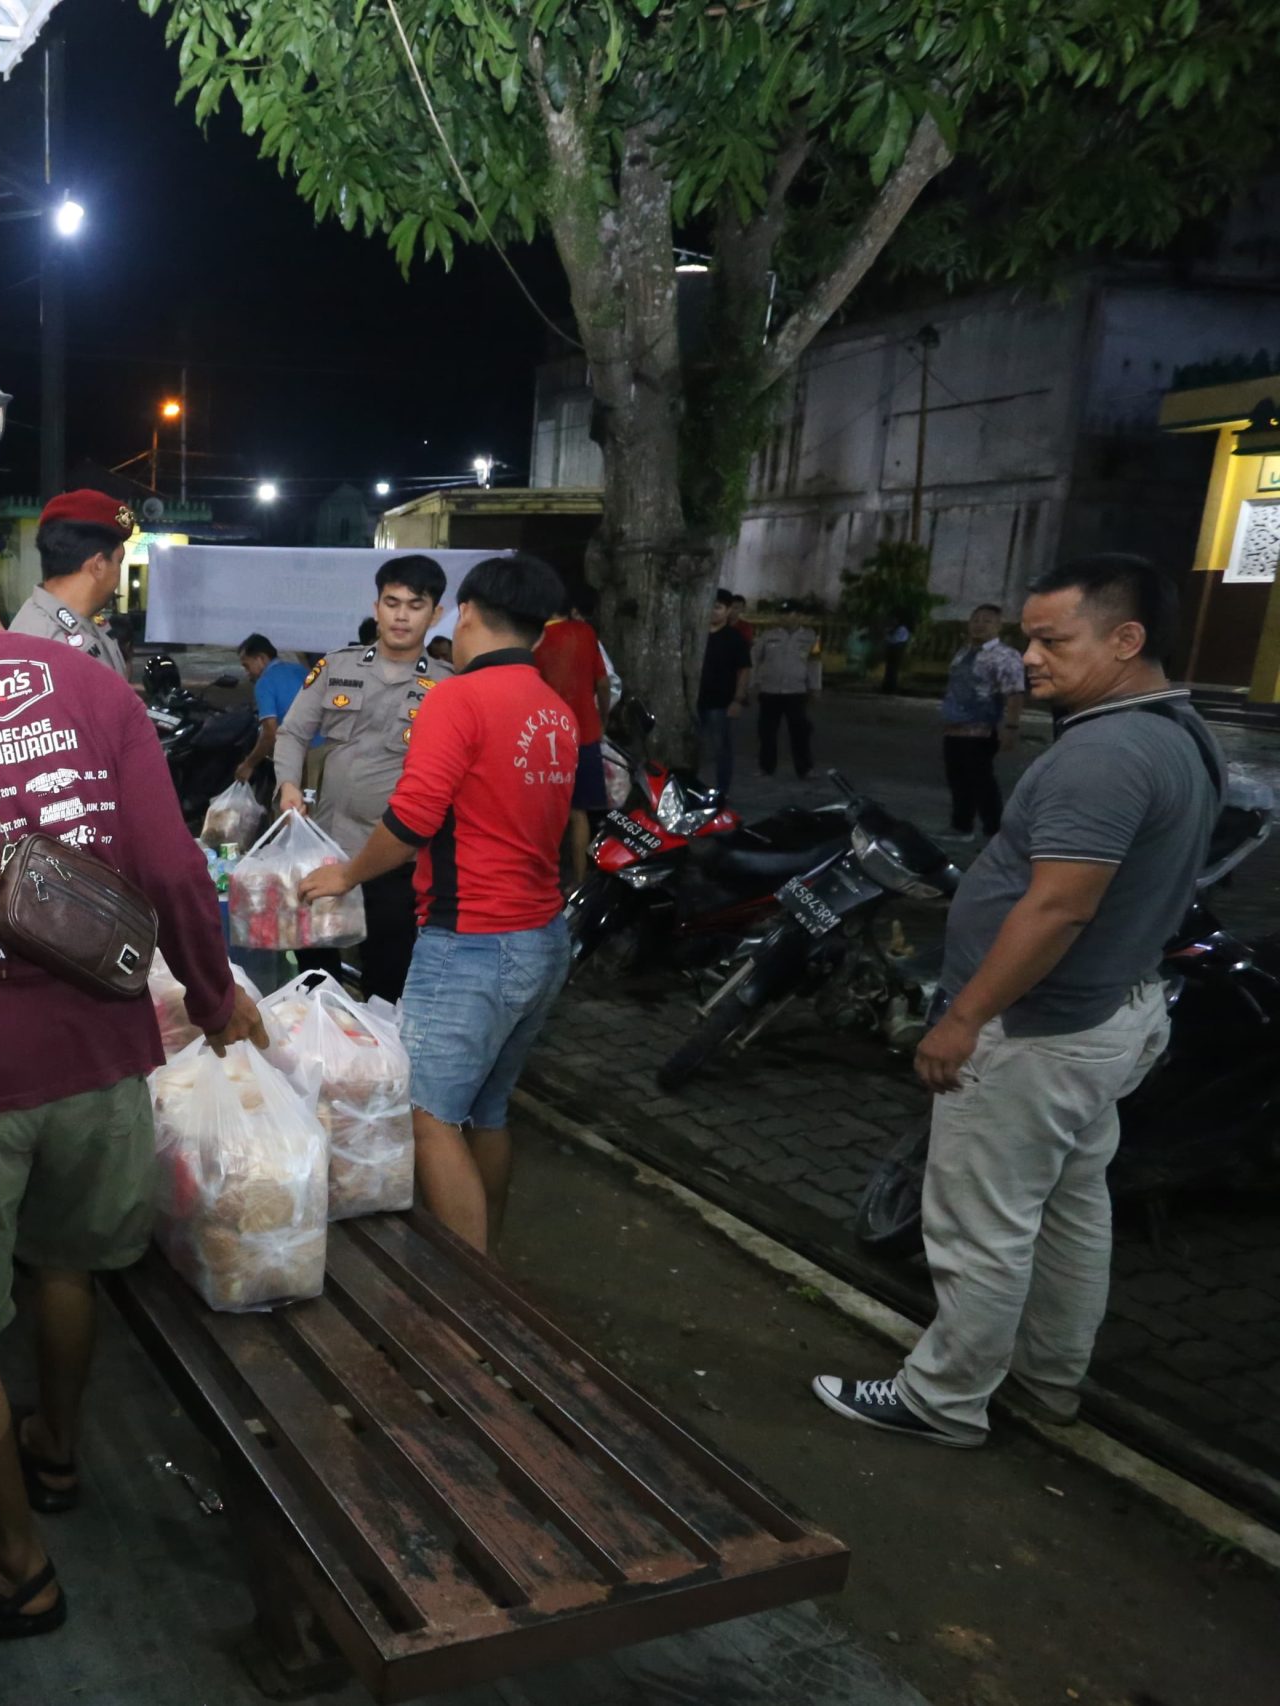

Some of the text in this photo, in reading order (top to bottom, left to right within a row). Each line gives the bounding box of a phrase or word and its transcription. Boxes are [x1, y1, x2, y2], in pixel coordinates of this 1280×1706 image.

[545, 730, 560, 766] 1
[0, 786, 18, 799] 2010
[638, 832, 662, 849] AAB
